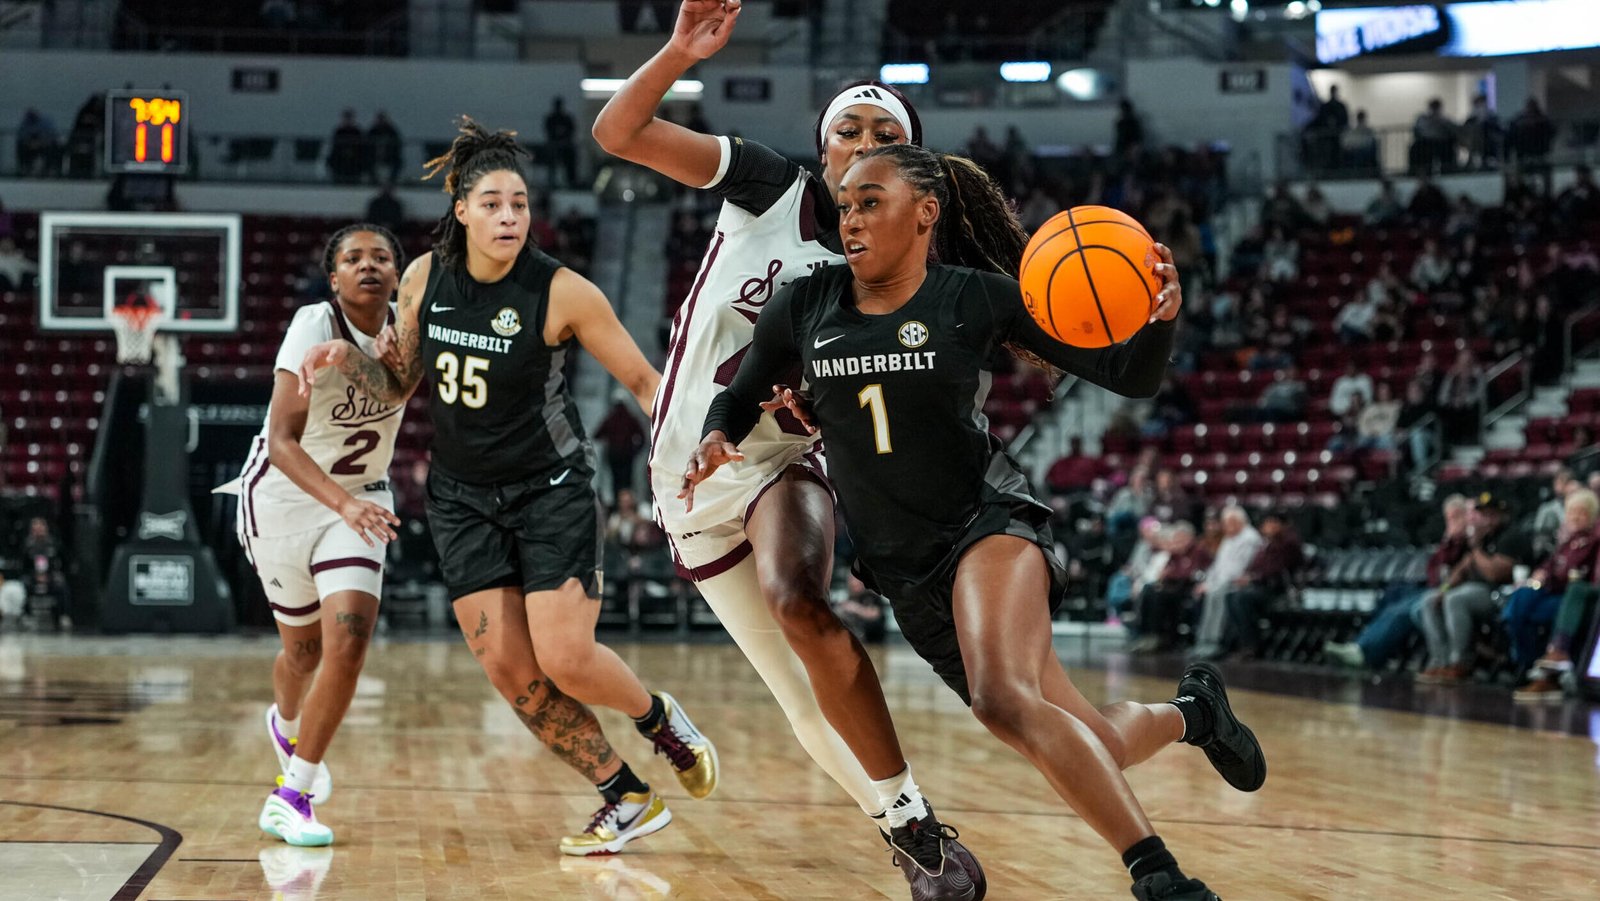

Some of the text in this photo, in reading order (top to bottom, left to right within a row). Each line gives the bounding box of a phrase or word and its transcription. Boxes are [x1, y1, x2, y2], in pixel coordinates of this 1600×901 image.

[135, 123, 173, 163] 11
[428, 323, 513, 354] VANDERBILT
[900, 322, 926, 346] SEC
[435, 351, 490, 409] 35
[812, 351, 936, 378] VANDERBILT
[858, 384, 893, 454] 1
[330, 430, 381, 475] 2
